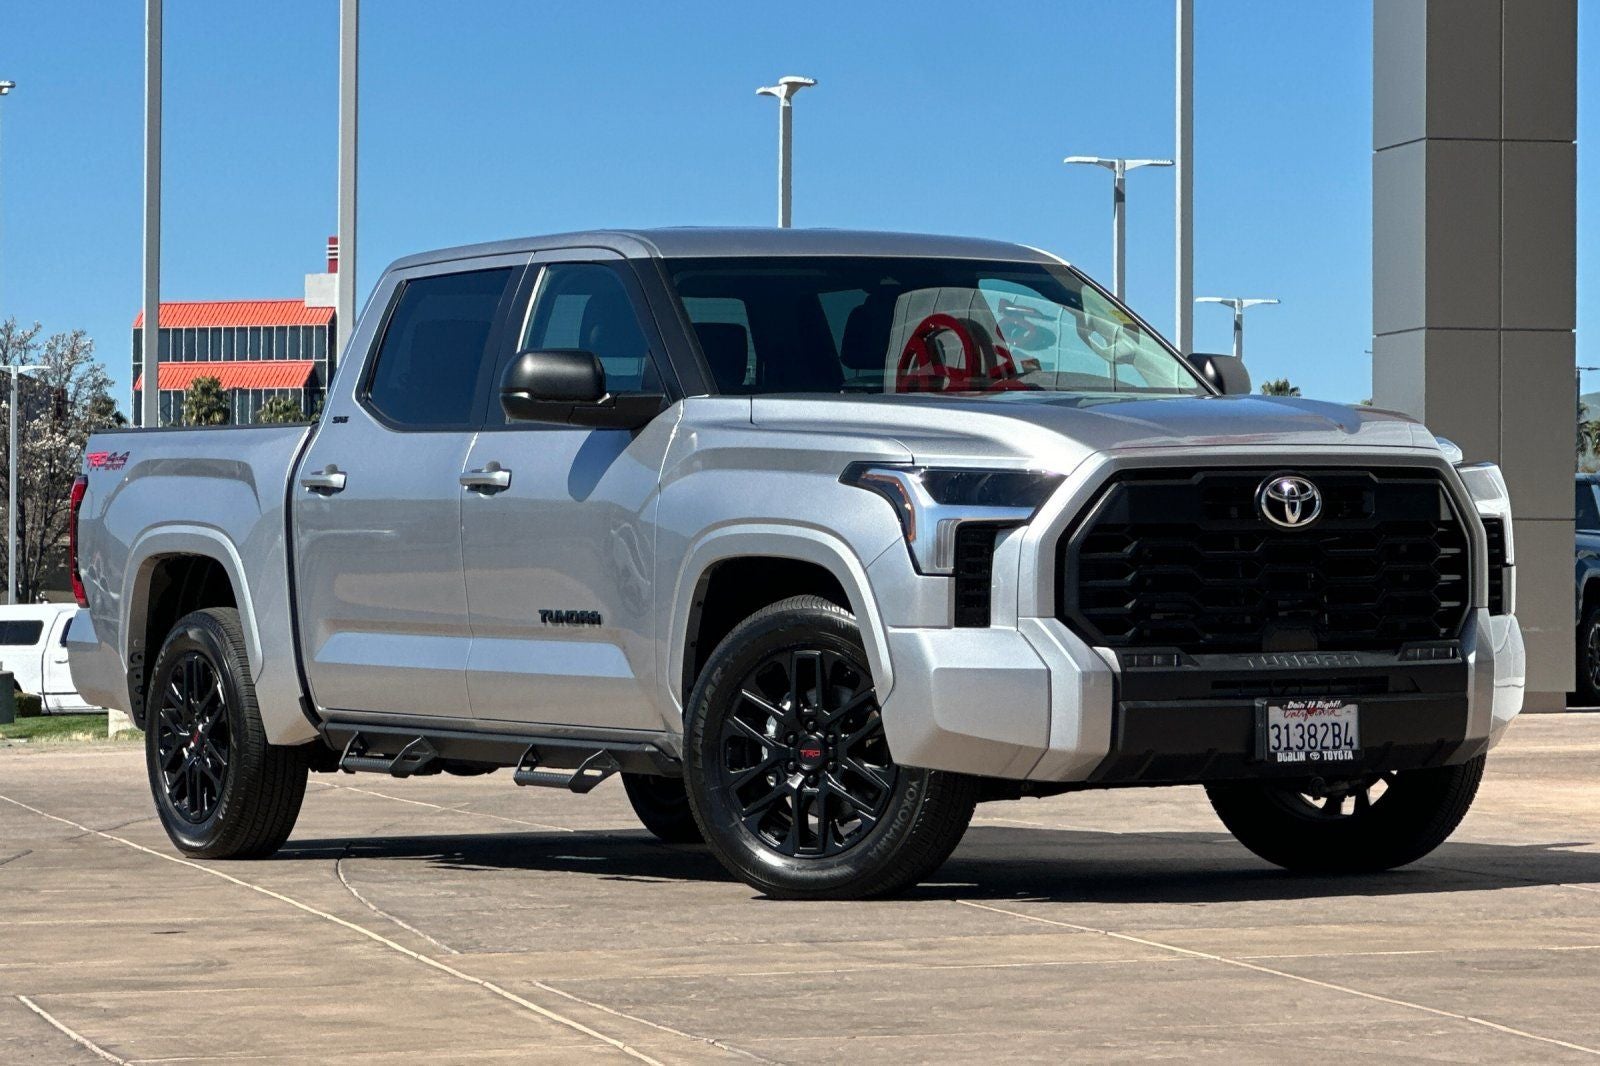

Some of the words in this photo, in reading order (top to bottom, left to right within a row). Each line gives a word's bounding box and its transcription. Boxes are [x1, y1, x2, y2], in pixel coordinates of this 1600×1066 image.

[538, 609, 602, 625] TUNDRA
[1240, 654, 1360, 668] TUNDRA
[1270, 722, 1354, 751] 31382B4
[800, 749, 820, 758] TRD
[1277, 752, 1306, 762] DUBLIN
[1323, 751, 1353, 761] TOYOTA
[867, 780, 919, 858] YOKOHAMA
